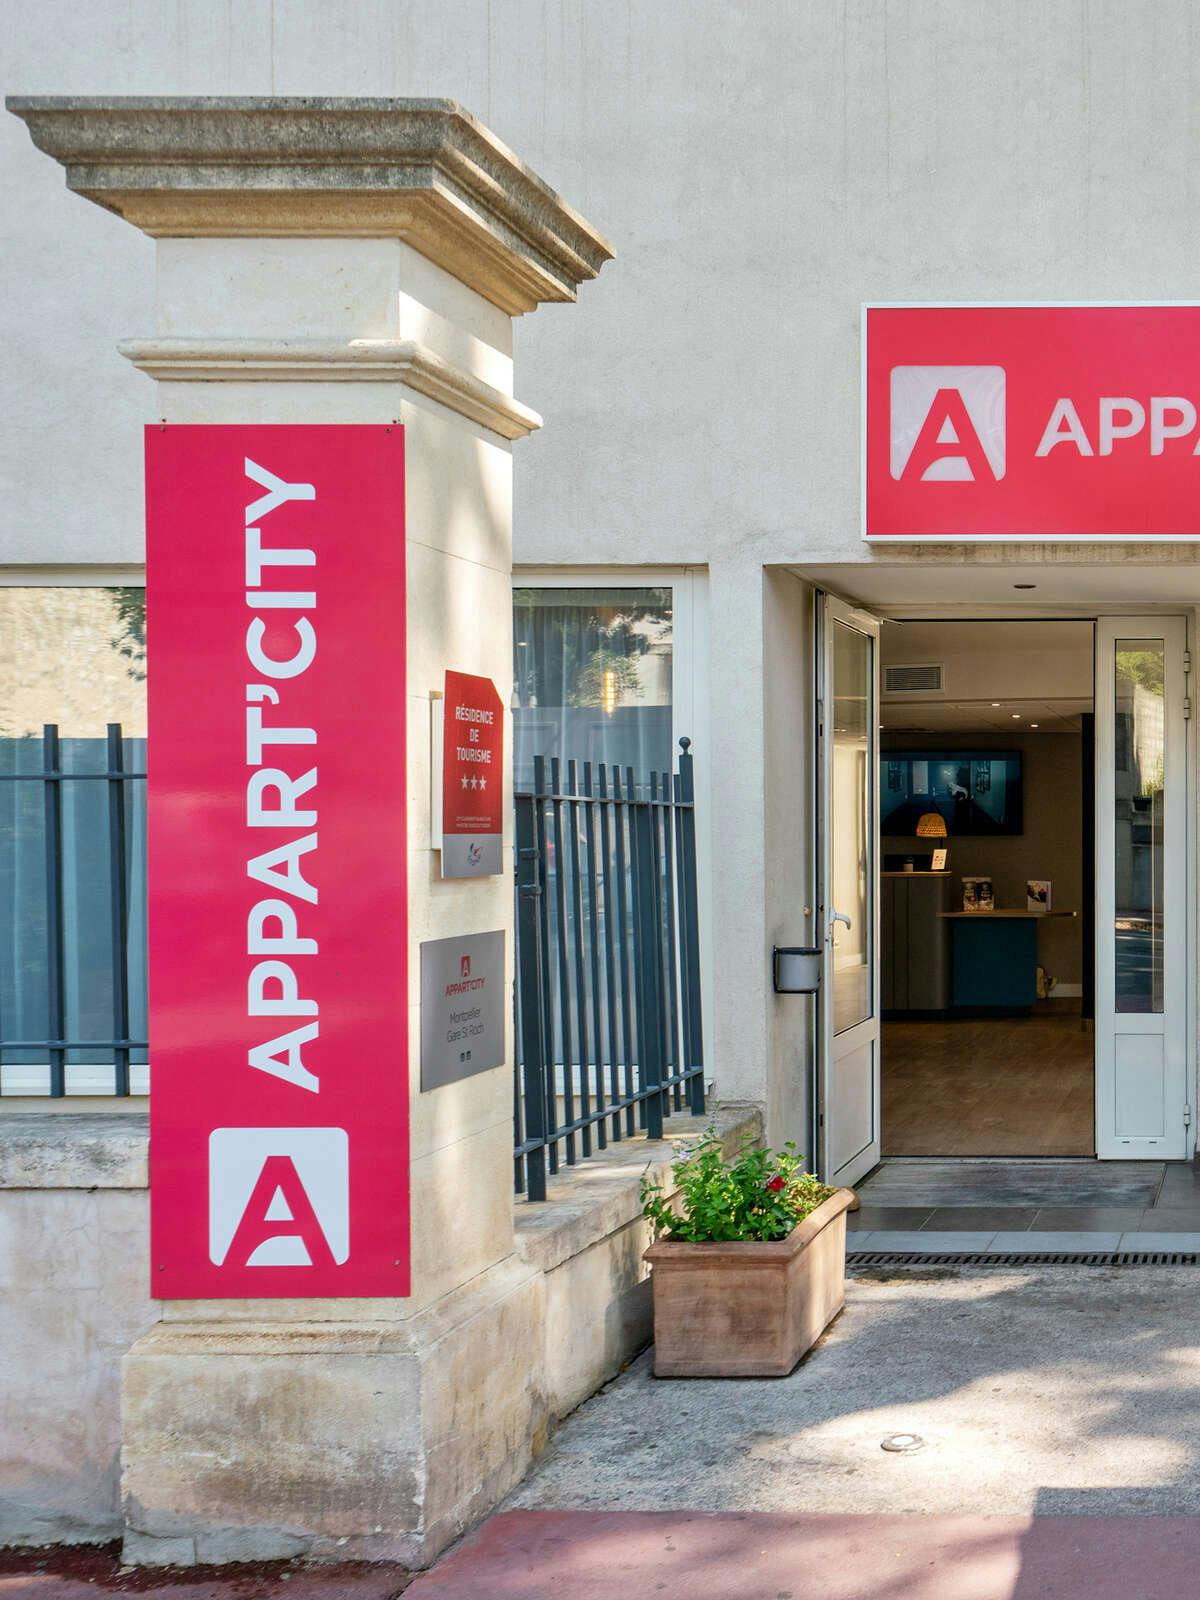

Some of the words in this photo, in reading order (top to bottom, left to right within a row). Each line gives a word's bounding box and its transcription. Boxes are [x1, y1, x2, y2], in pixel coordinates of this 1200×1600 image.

[894, 382, 1002, 481] A
[455, 703, 494, 726] RÉSIDENCE
[469, 729, 480, 743] DE
[456, 746, 492, 764] TOURISME
[220, 1153, 340, 1267] A
